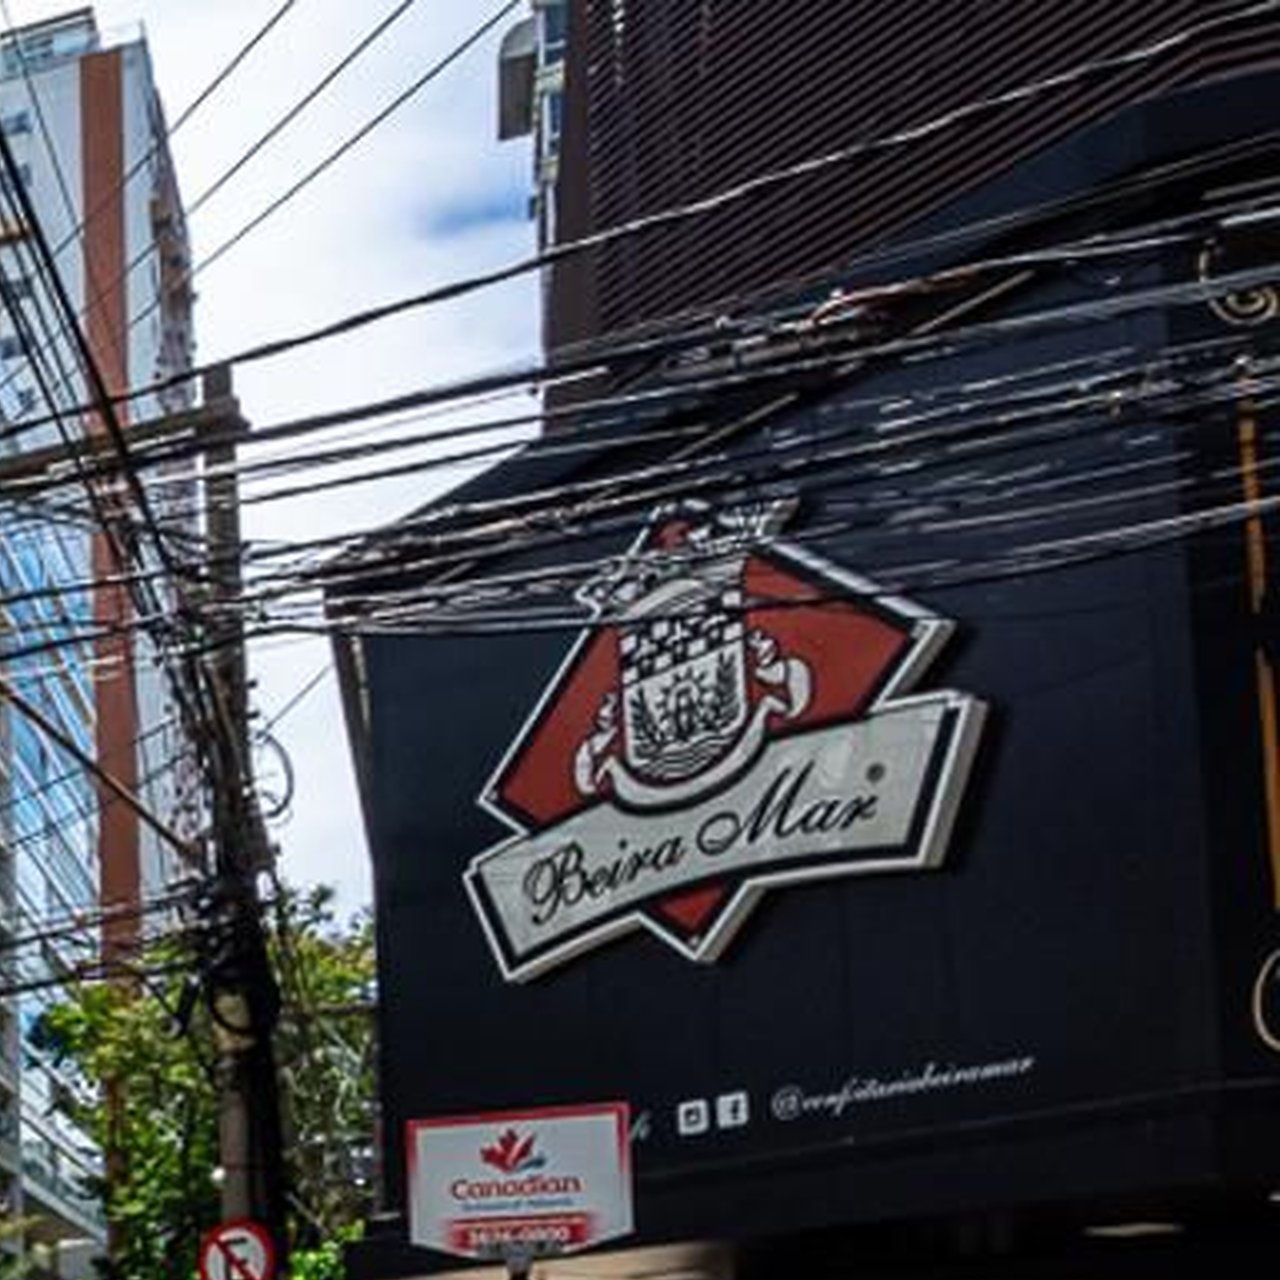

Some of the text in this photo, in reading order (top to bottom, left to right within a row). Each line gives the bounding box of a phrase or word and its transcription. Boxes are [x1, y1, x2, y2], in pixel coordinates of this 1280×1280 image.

[523, 759, 879, 925] Beira Mar
[451, 1174, 582, 1200] Canadian
